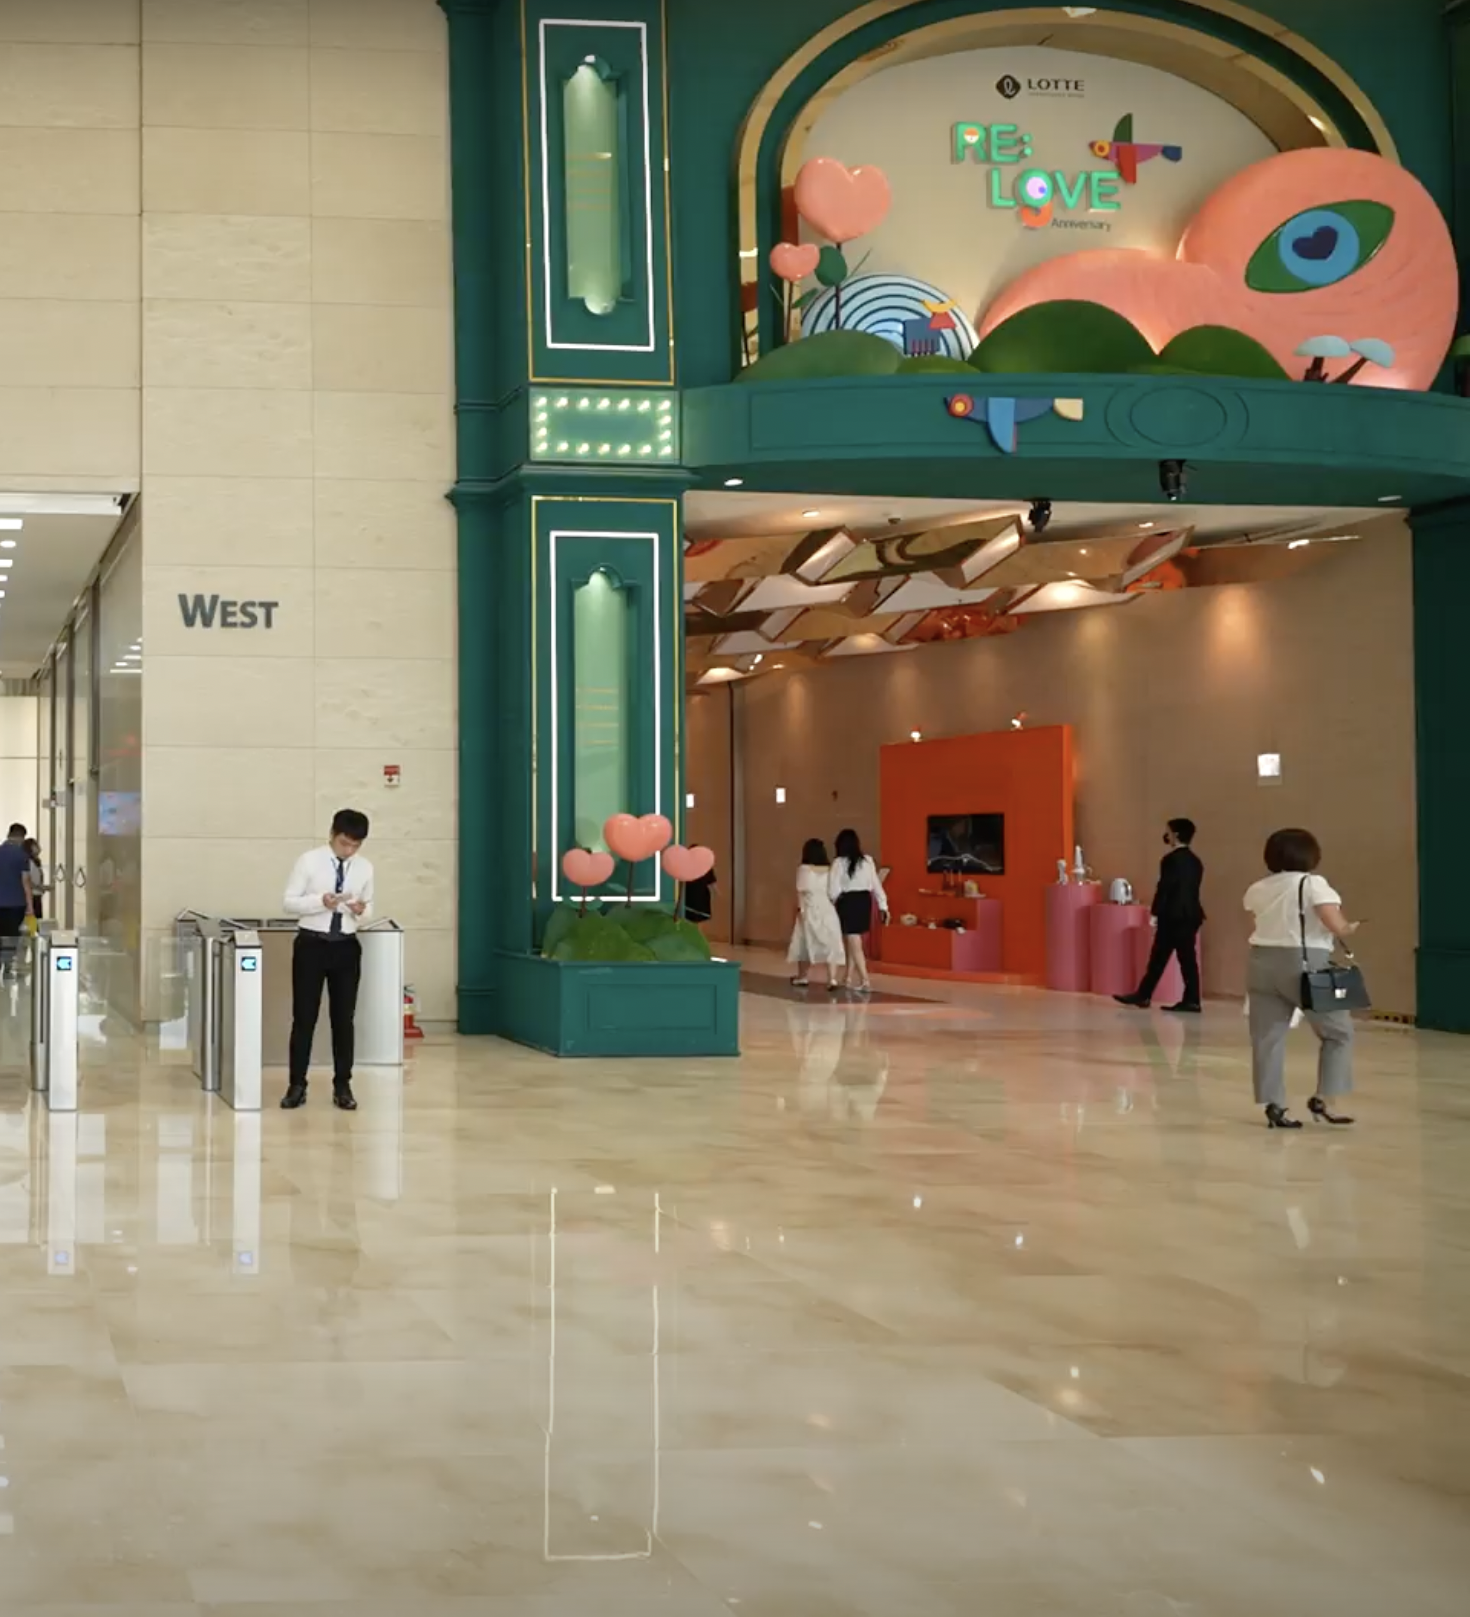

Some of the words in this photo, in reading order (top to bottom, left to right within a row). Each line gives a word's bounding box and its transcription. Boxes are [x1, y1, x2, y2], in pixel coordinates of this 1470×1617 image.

[1028, 78, 1084, 91] LOTTE
[953, 122, 1032, 162] RE:
[989, 168, 1121, 211] LOVE
[1051, 218, 1112, 231] Anniversary
